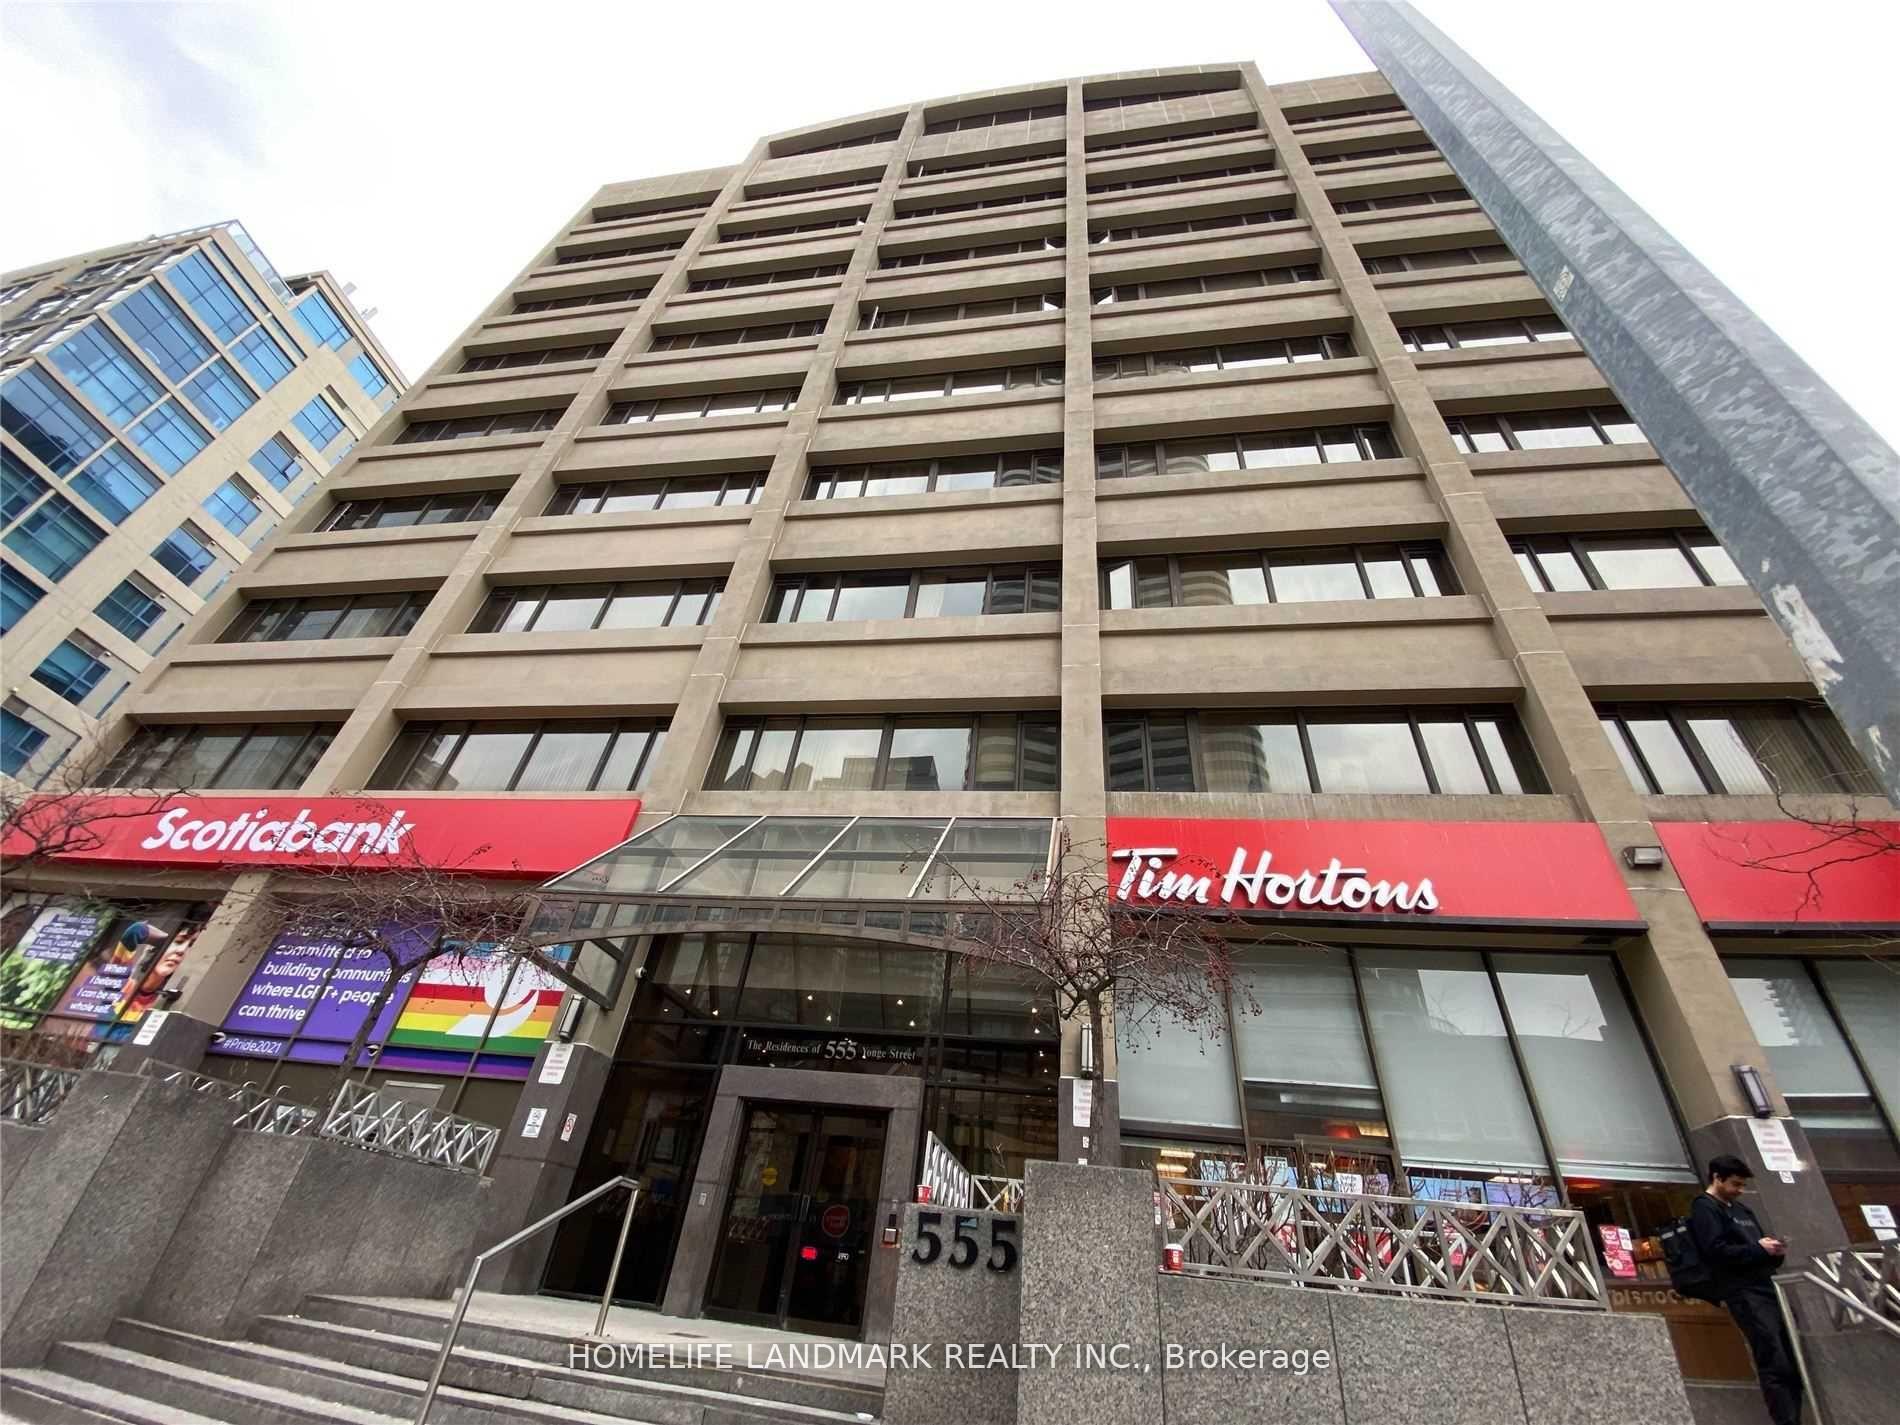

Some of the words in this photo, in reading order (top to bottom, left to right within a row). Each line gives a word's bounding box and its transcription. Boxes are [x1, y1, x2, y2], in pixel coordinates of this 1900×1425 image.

[141, 808, 416, 855] Scotiabank
[1111, 847, 1213, 904] Tim
[1220, 846, 1440, 911] Hortons
[104, 963, 128, 974] When
[262, 961, 322, 981] building
[81, 989, 97, 998] can
[96, 989, 108, 999] be
[251, 982, 294, 998] where
[338, 989, 395, 1007] peop
[69, 1001, 95, 1012] whole
[238, 1004, 266, 1016] can
[265, 1003, 306, 1021] thrive
[223, 1037, 282, 1054] #Pride2021
[747, 1039, 762, 1050] The
[766, 1041, 809, 1054] Residences
[812, 1043, 822, 1054] of
[823, 1040, 859, 1061] 555
[861, 1046, 888, 1060] Yonge
[889, 1047, 917, 1061] Street
[912, 1212, 1017, 1273] 555
